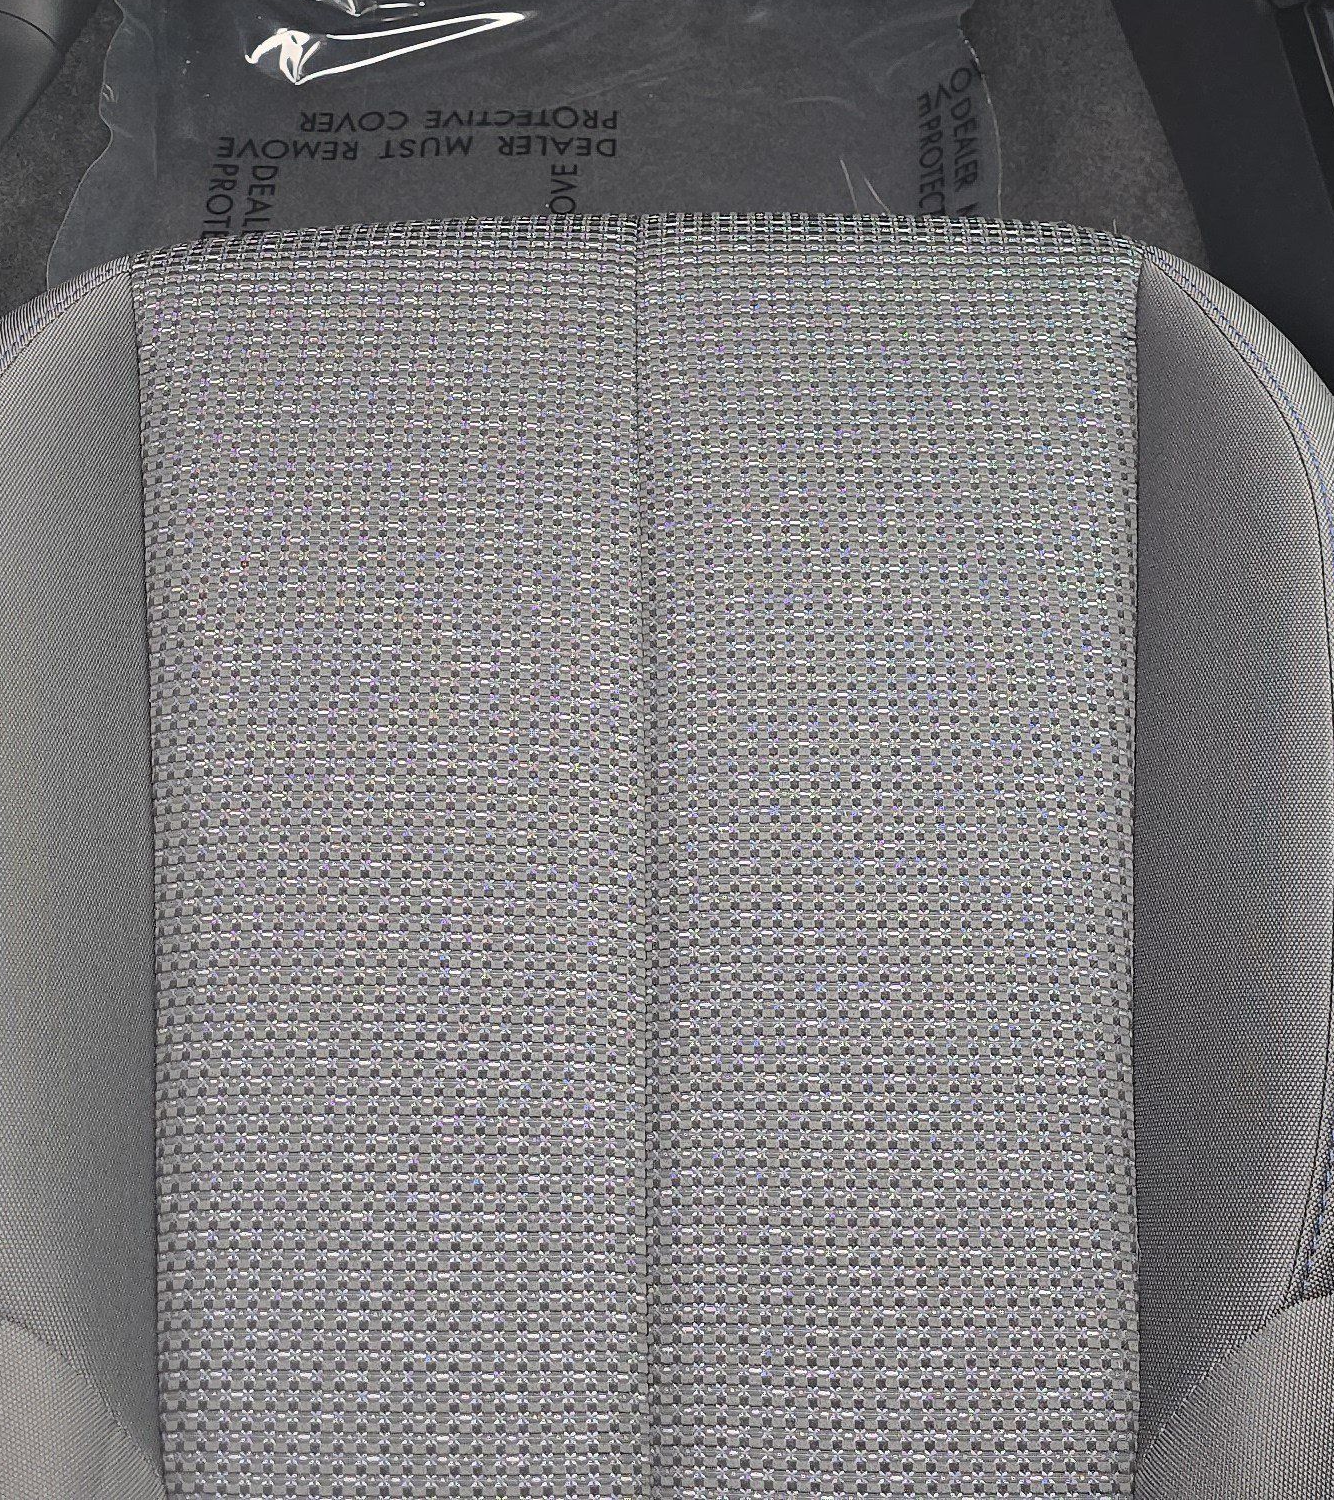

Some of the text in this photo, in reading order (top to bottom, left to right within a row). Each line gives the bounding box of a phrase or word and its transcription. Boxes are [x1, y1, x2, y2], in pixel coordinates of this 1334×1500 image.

[300, 105, 618, 134] PROTECTIVE COVER
[216, 135, 616, 161] DEALER MUST REMOVE
